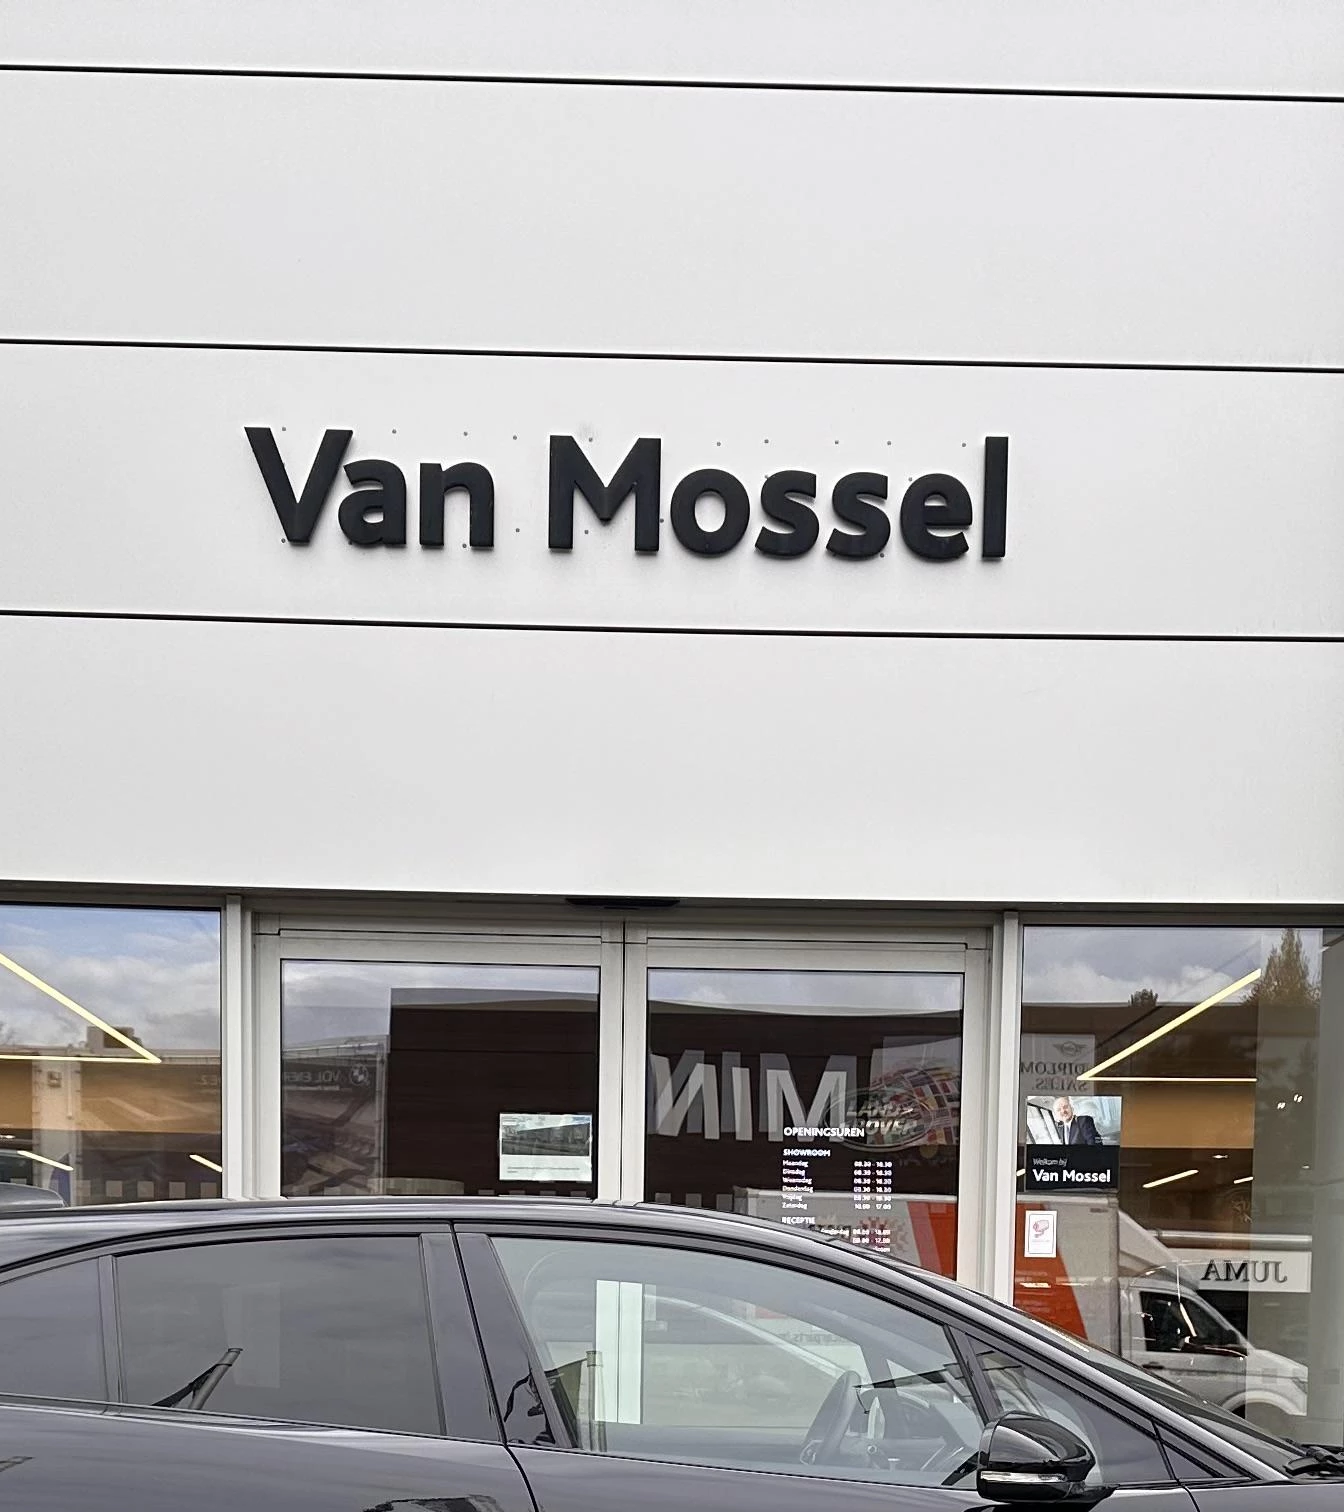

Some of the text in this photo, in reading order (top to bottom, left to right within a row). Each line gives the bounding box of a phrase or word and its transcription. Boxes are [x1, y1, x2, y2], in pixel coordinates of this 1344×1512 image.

[243, 426, 1010, 564] Van Mossel
[783, 1126, 865, 1138] OPENINGSUREN
[782, 1149, 831, 1157] SHOWROOM
[1032, 1169, 1111, 1183] Van Mossel
